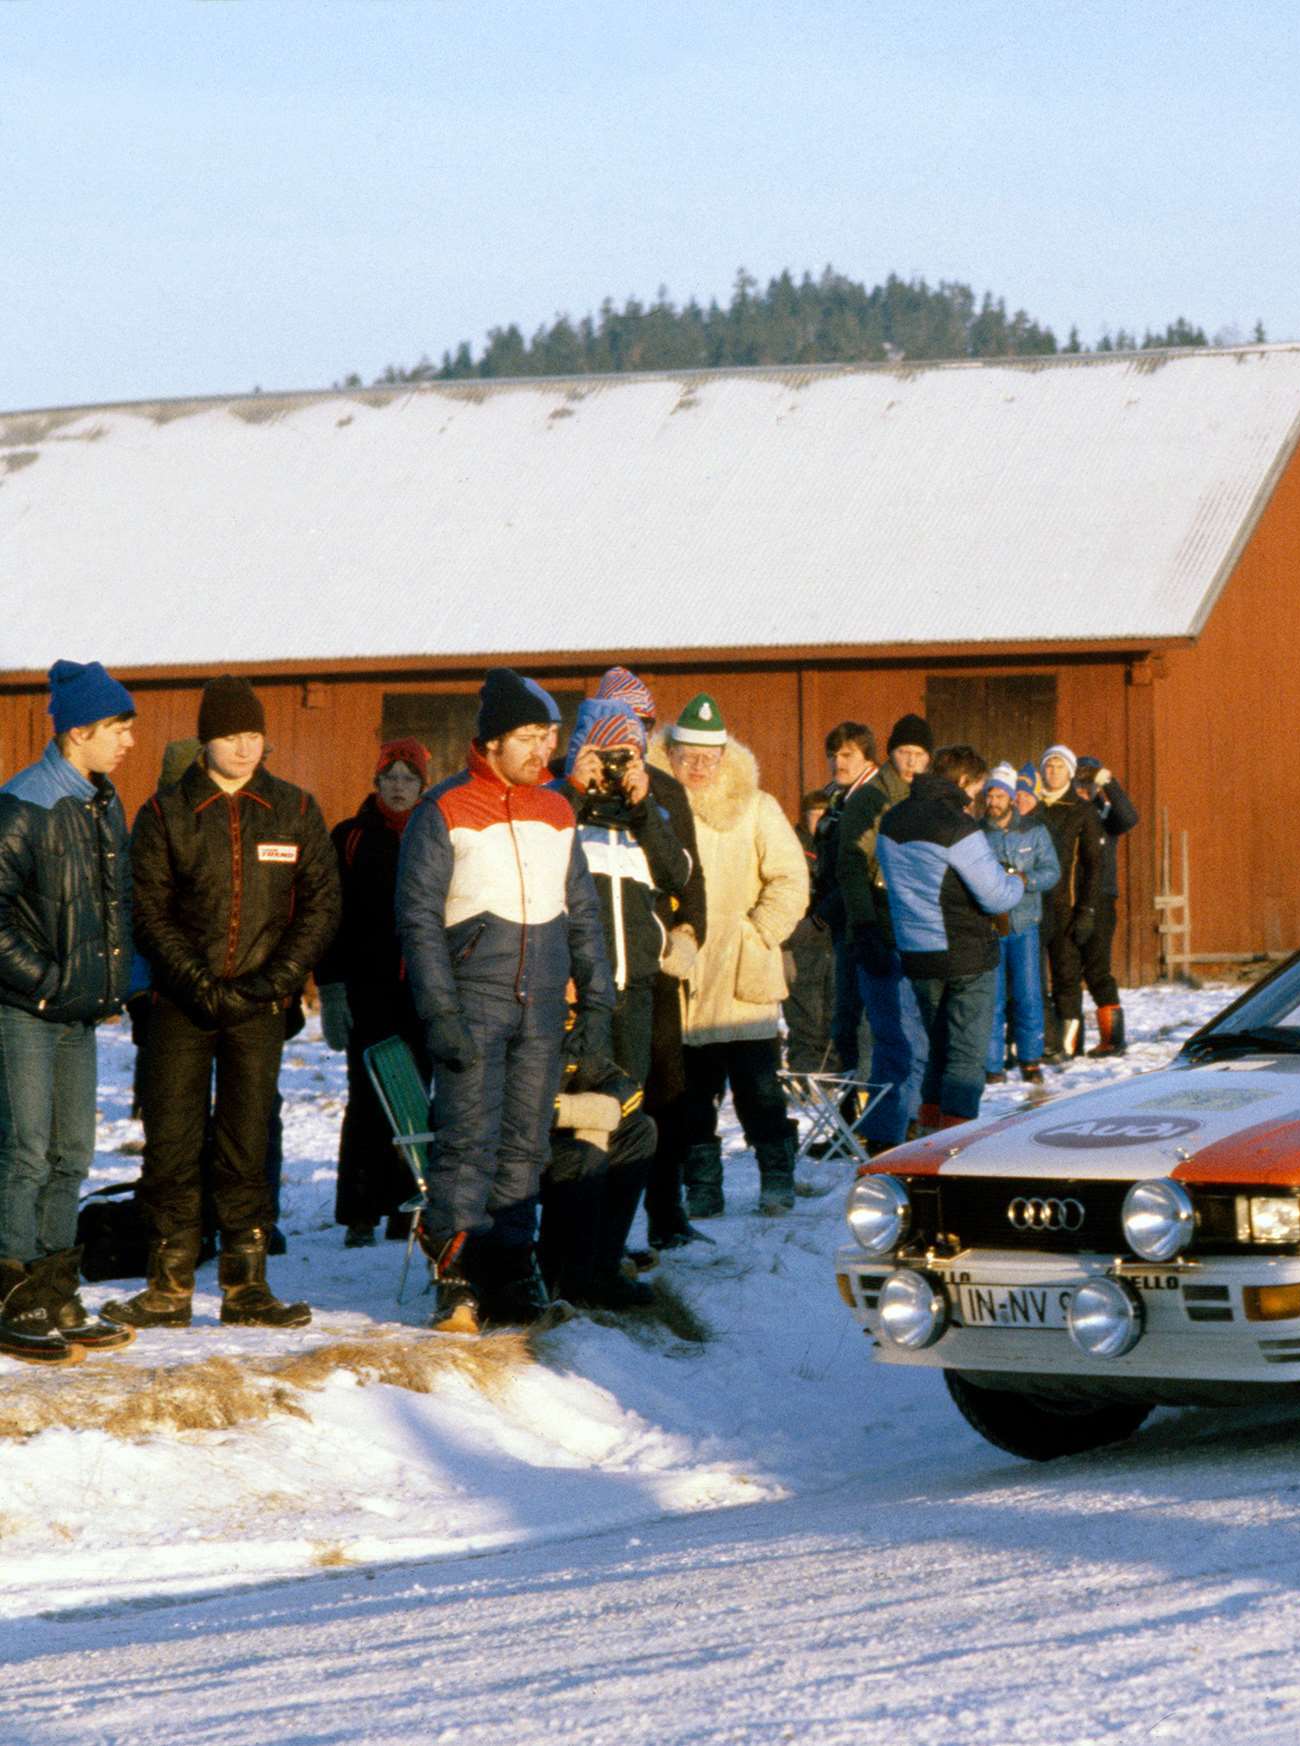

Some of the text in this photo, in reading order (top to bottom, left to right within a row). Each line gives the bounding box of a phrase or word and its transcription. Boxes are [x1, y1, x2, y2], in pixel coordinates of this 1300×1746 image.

[1043, 1121, 1189, 1137] Audi
[1128, 1274, 1181, 1291] ELLO
[967, 1288, 1048, 1324] IN-NV
